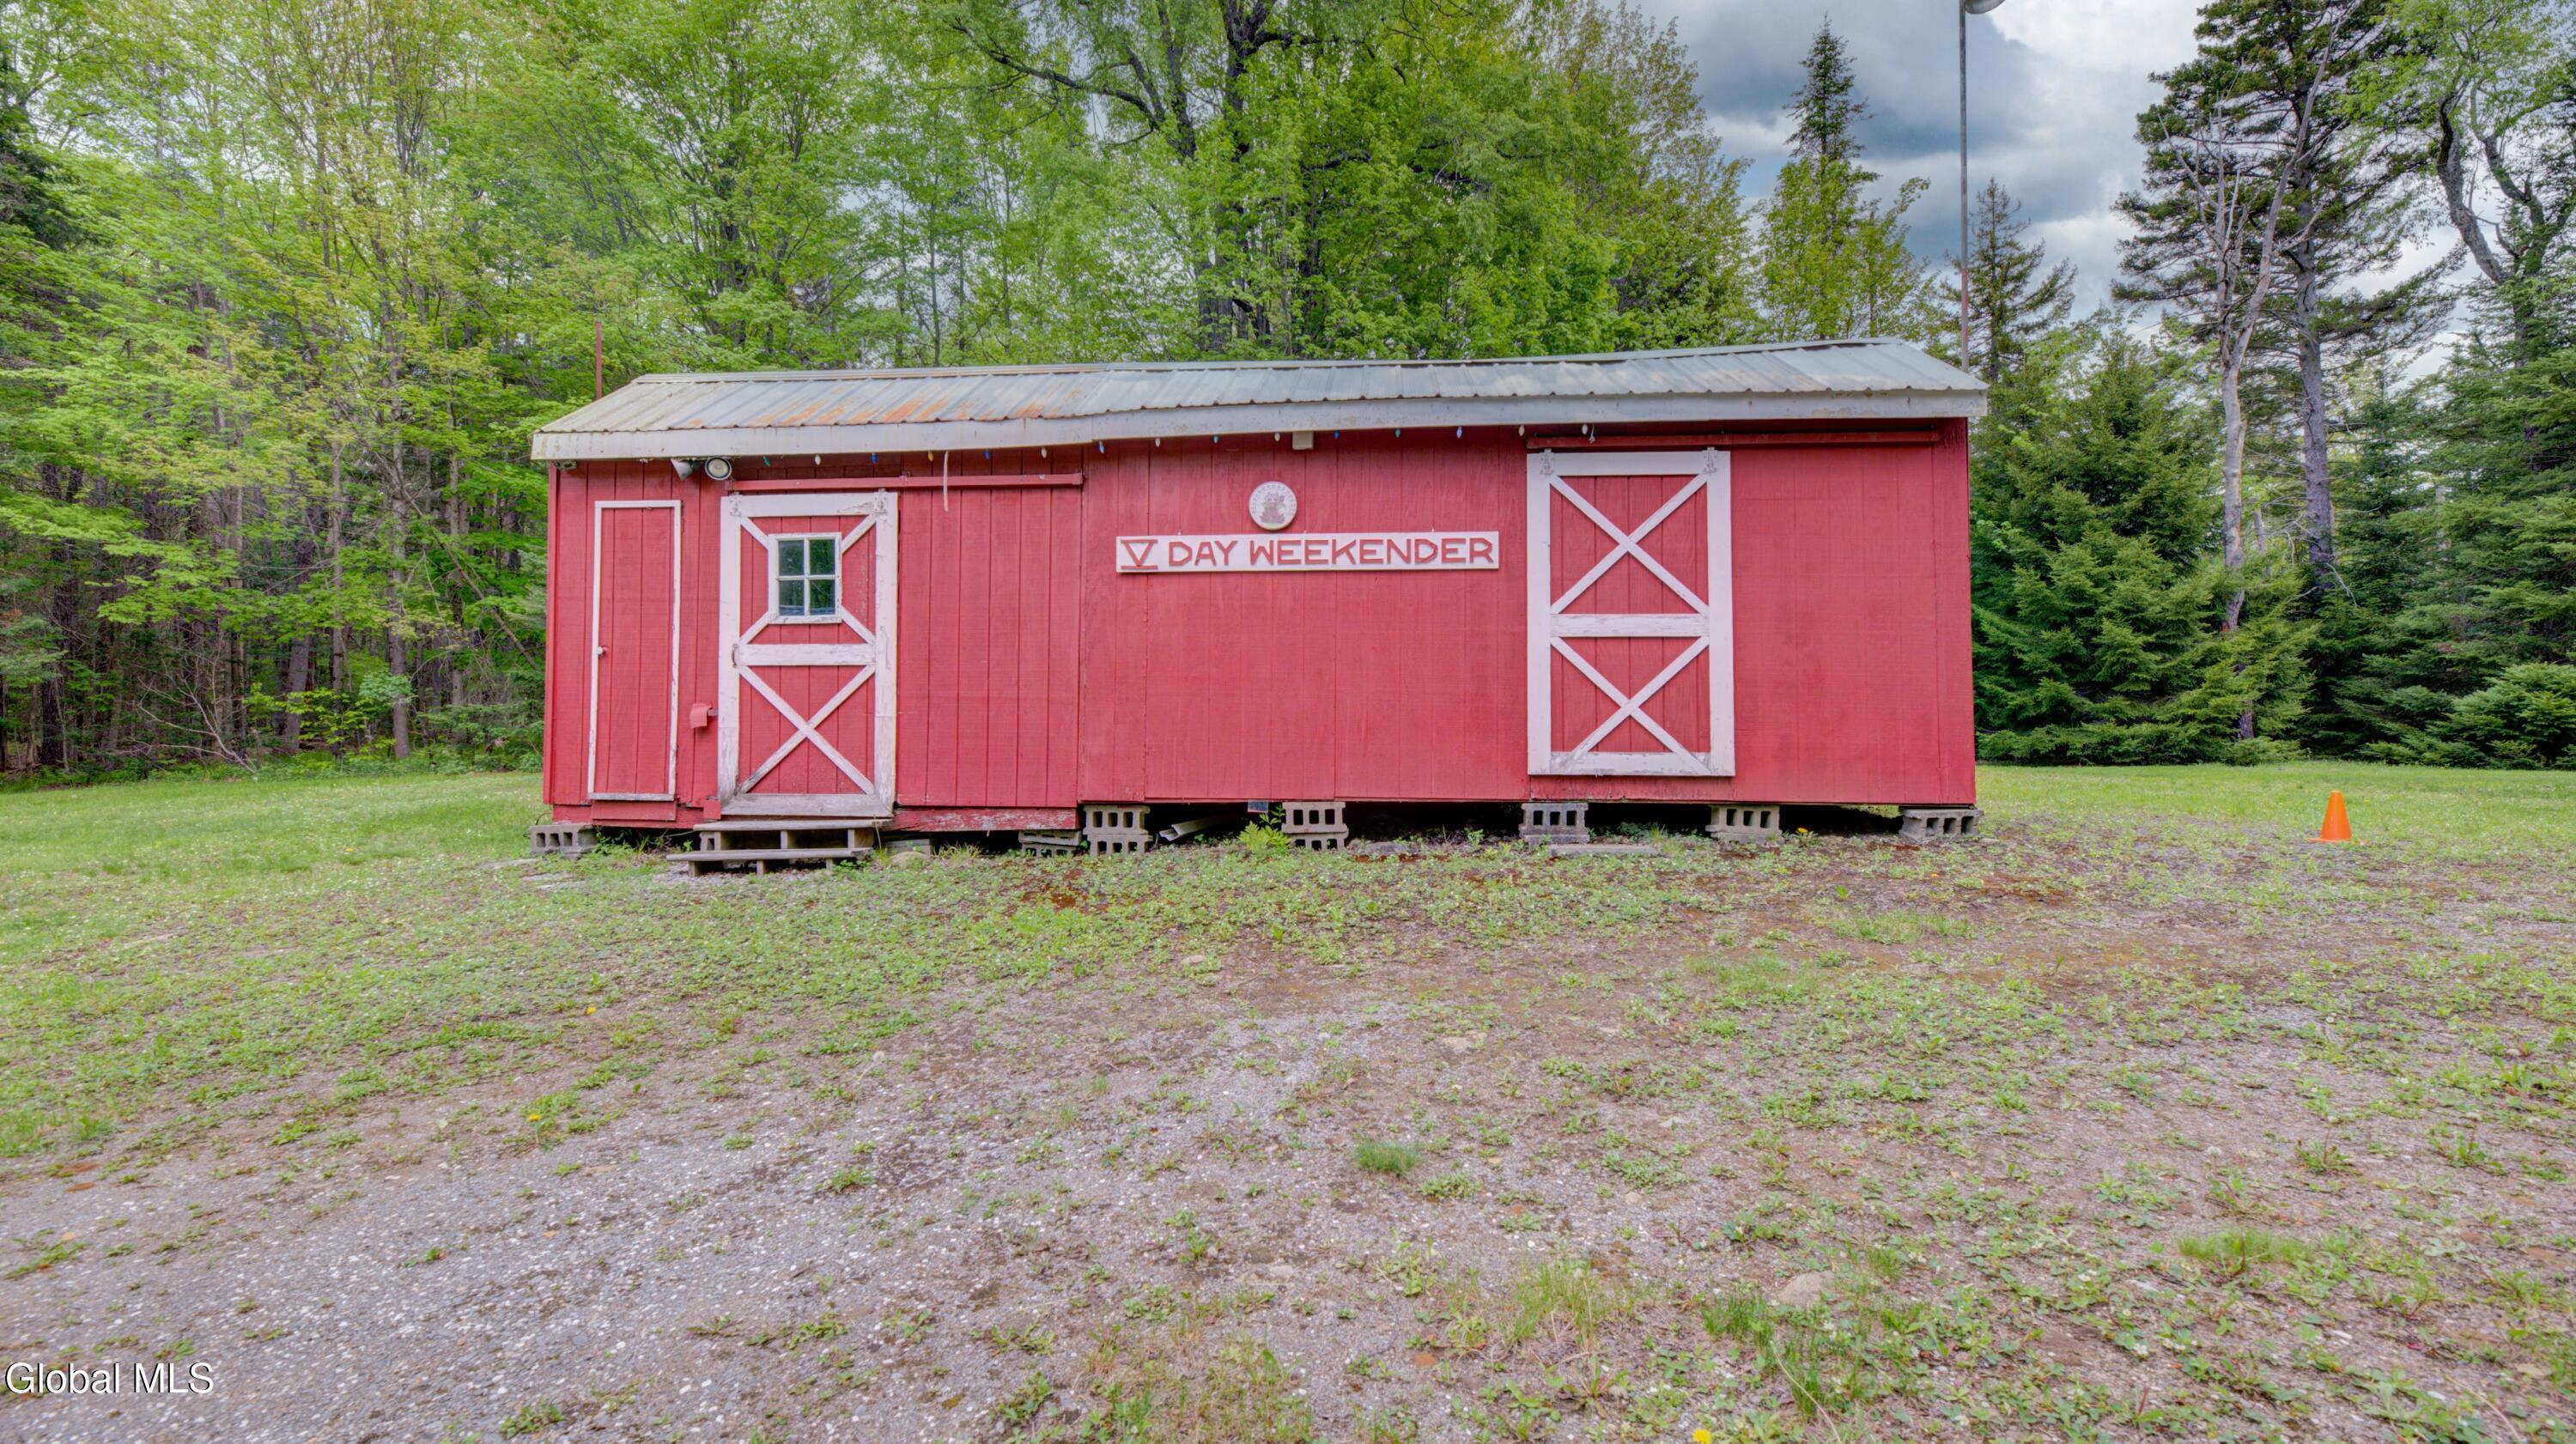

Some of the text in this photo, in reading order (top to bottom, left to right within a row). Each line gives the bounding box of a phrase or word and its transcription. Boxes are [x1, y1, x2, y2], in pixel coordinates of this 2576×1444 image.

[1121, 537, 1494, 570] V DAY WEEKENDER
